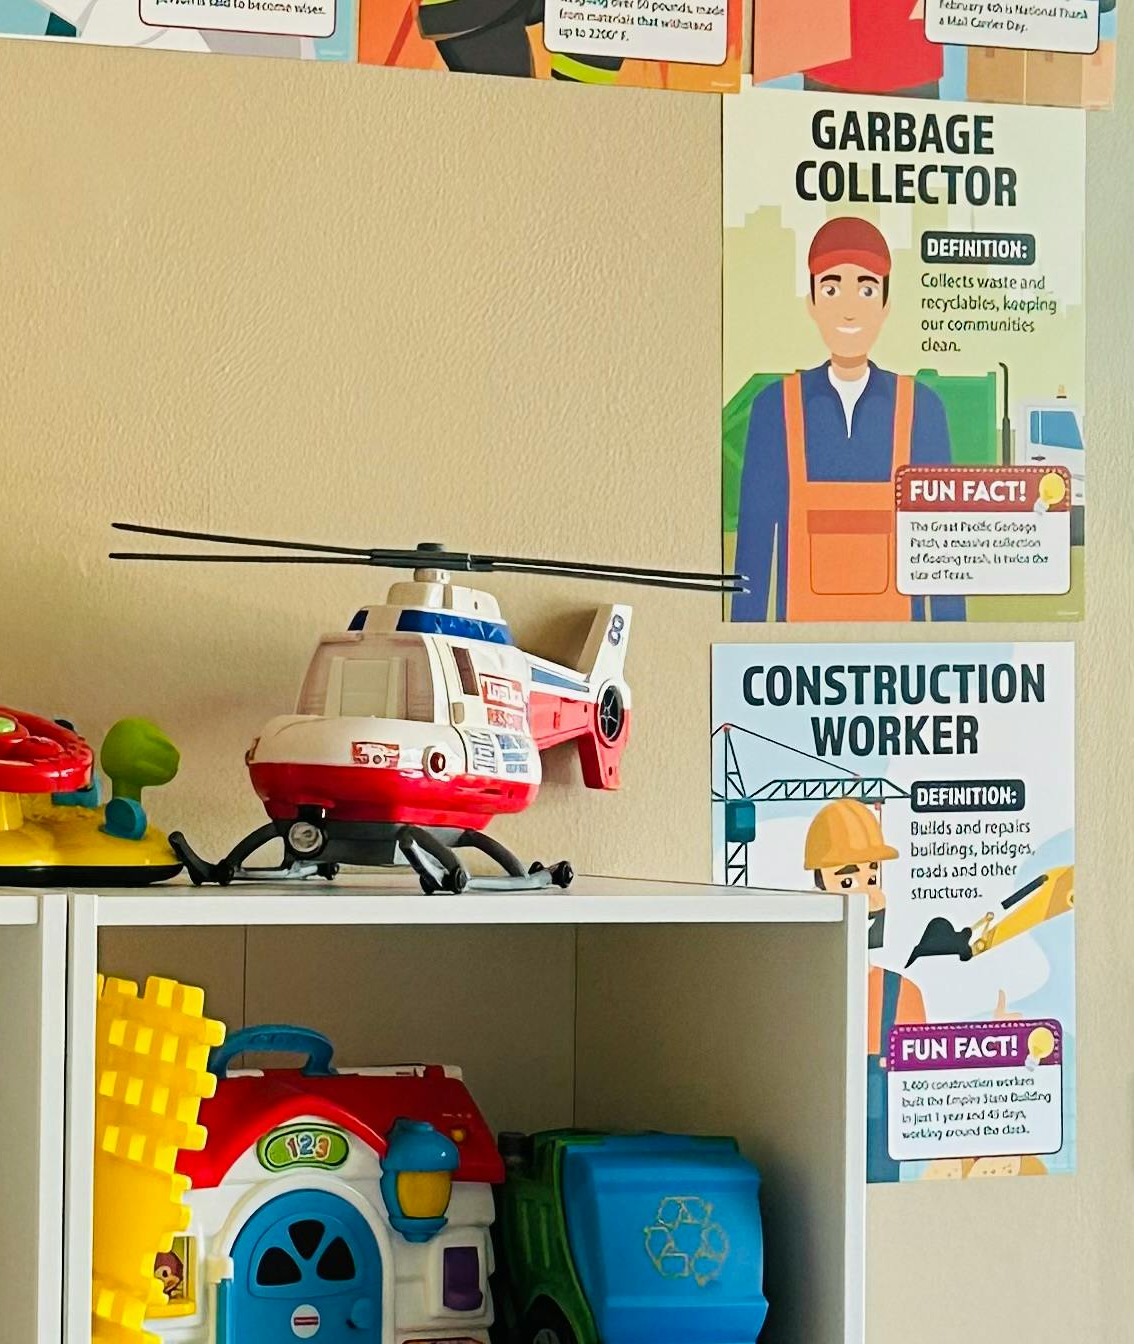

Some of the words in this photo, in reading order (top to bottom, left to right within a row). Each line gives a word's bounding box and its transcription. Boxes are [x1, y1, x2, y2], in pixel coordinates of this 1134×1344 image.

[811, 109, 994, 155] GARBAGE
[795, 160, 1016, 206] COLLECTOR
[927, 238, 1027, 258] DEFINITION:
[920, 272, 974, 288] Collects
[976, 276, 1017, 289] waste
[1020, 275, 1045, 289] and
[921, 319, 944, 330] our
[947, 317, 1034, 332] communities
[910, 479, 955, 501] FUN
[962, 480, 1026, 502] FACT!
[608, 614, 624, 646] 8
[742, 663, 1044, 706] CONSTRUCTION
[811, 715, 978, 756] WORKER
[916, 786, 1016, 805] DEFINITION:
[910, 841, 977, 859] buildings,
[981, 840, 1035, 859] bridges,
[911, 864, 947, 878] roads
[951, 862, 976, 877] and
[980, 861, 1017, 876] other
[902, 1037, 947, 1061] FUN
[954, 1034, 1017, 1058] FACT!
